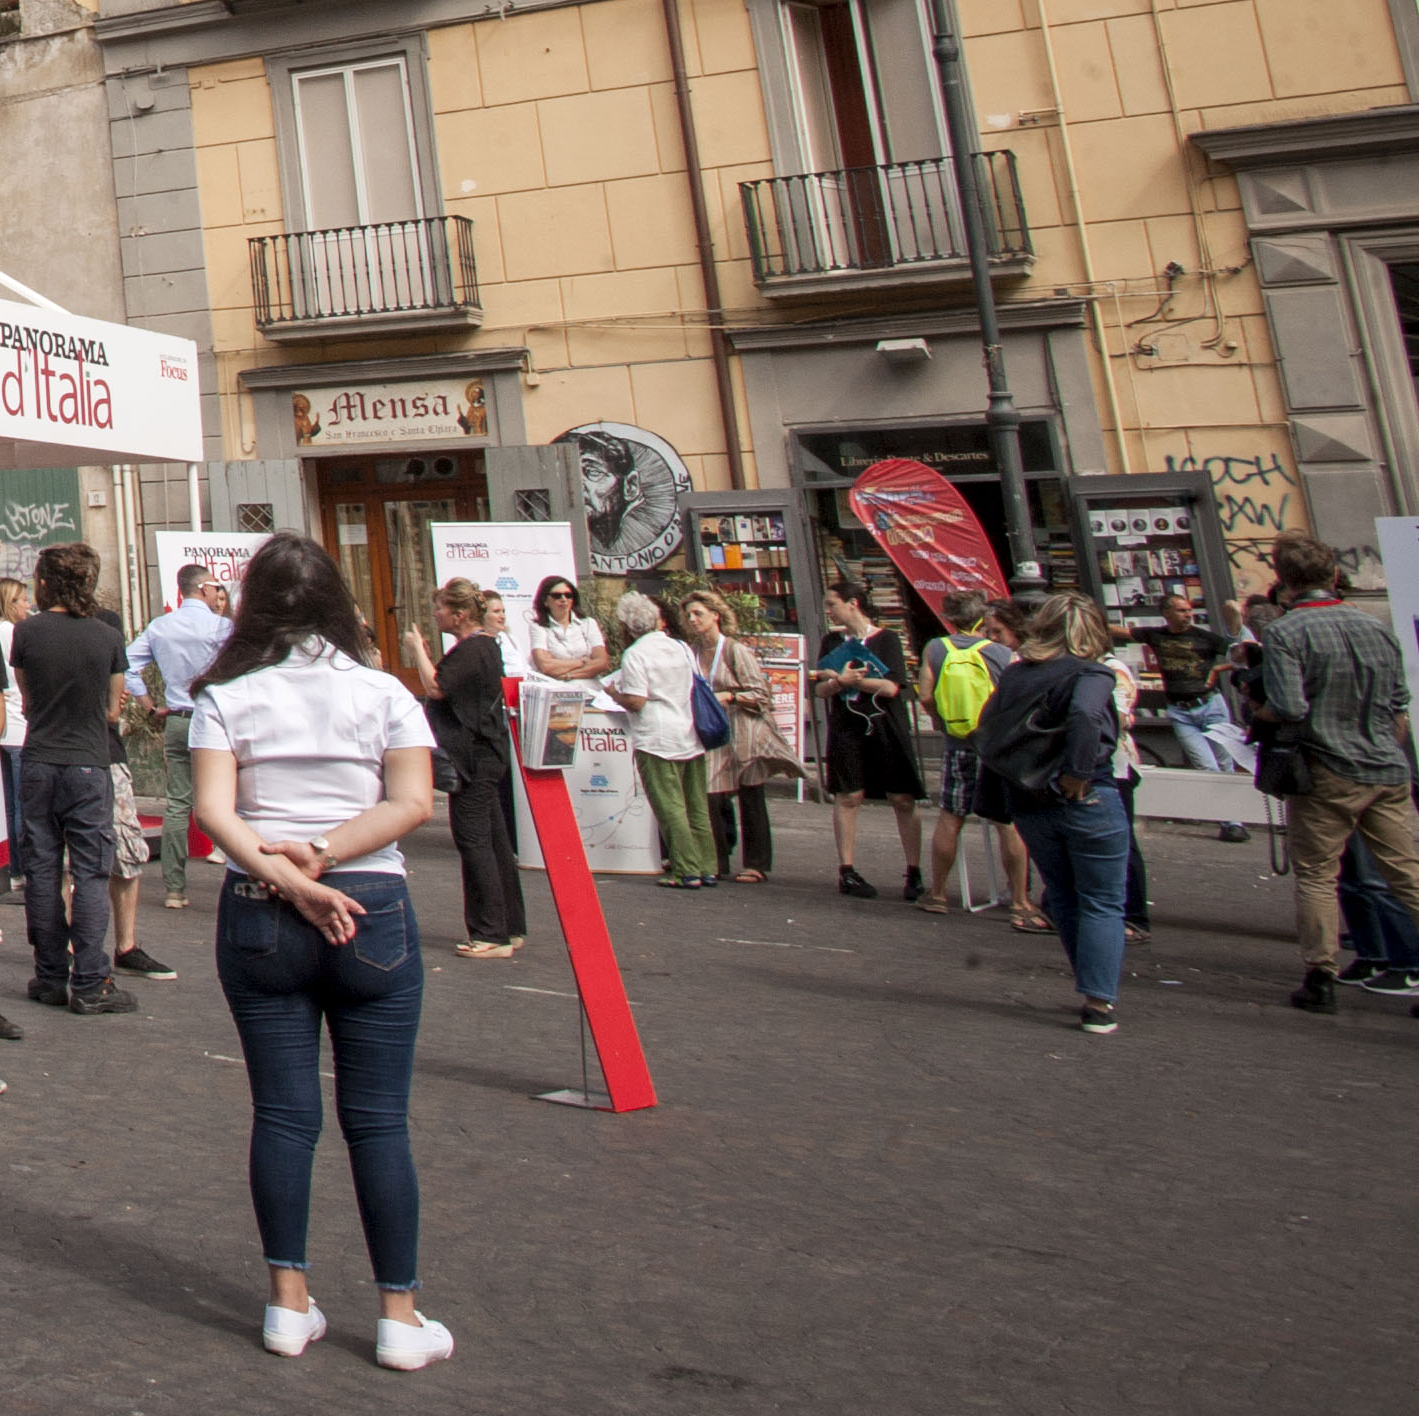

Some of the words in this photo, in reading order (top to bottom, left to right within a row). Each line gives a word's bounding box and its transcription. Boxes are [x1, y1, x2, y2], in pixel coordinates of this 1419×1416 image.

[160, 359, 188, 381] Focus
[1, 346, 114, 430] d'Italia
[328, 391, 451, 427] Mensa
[922, 452, 933, 463] &
[934, 451, 989, 463] Descartes
[183, 546, 251, 558] PANORAMA
[580, 732, 628, 752] Italia
